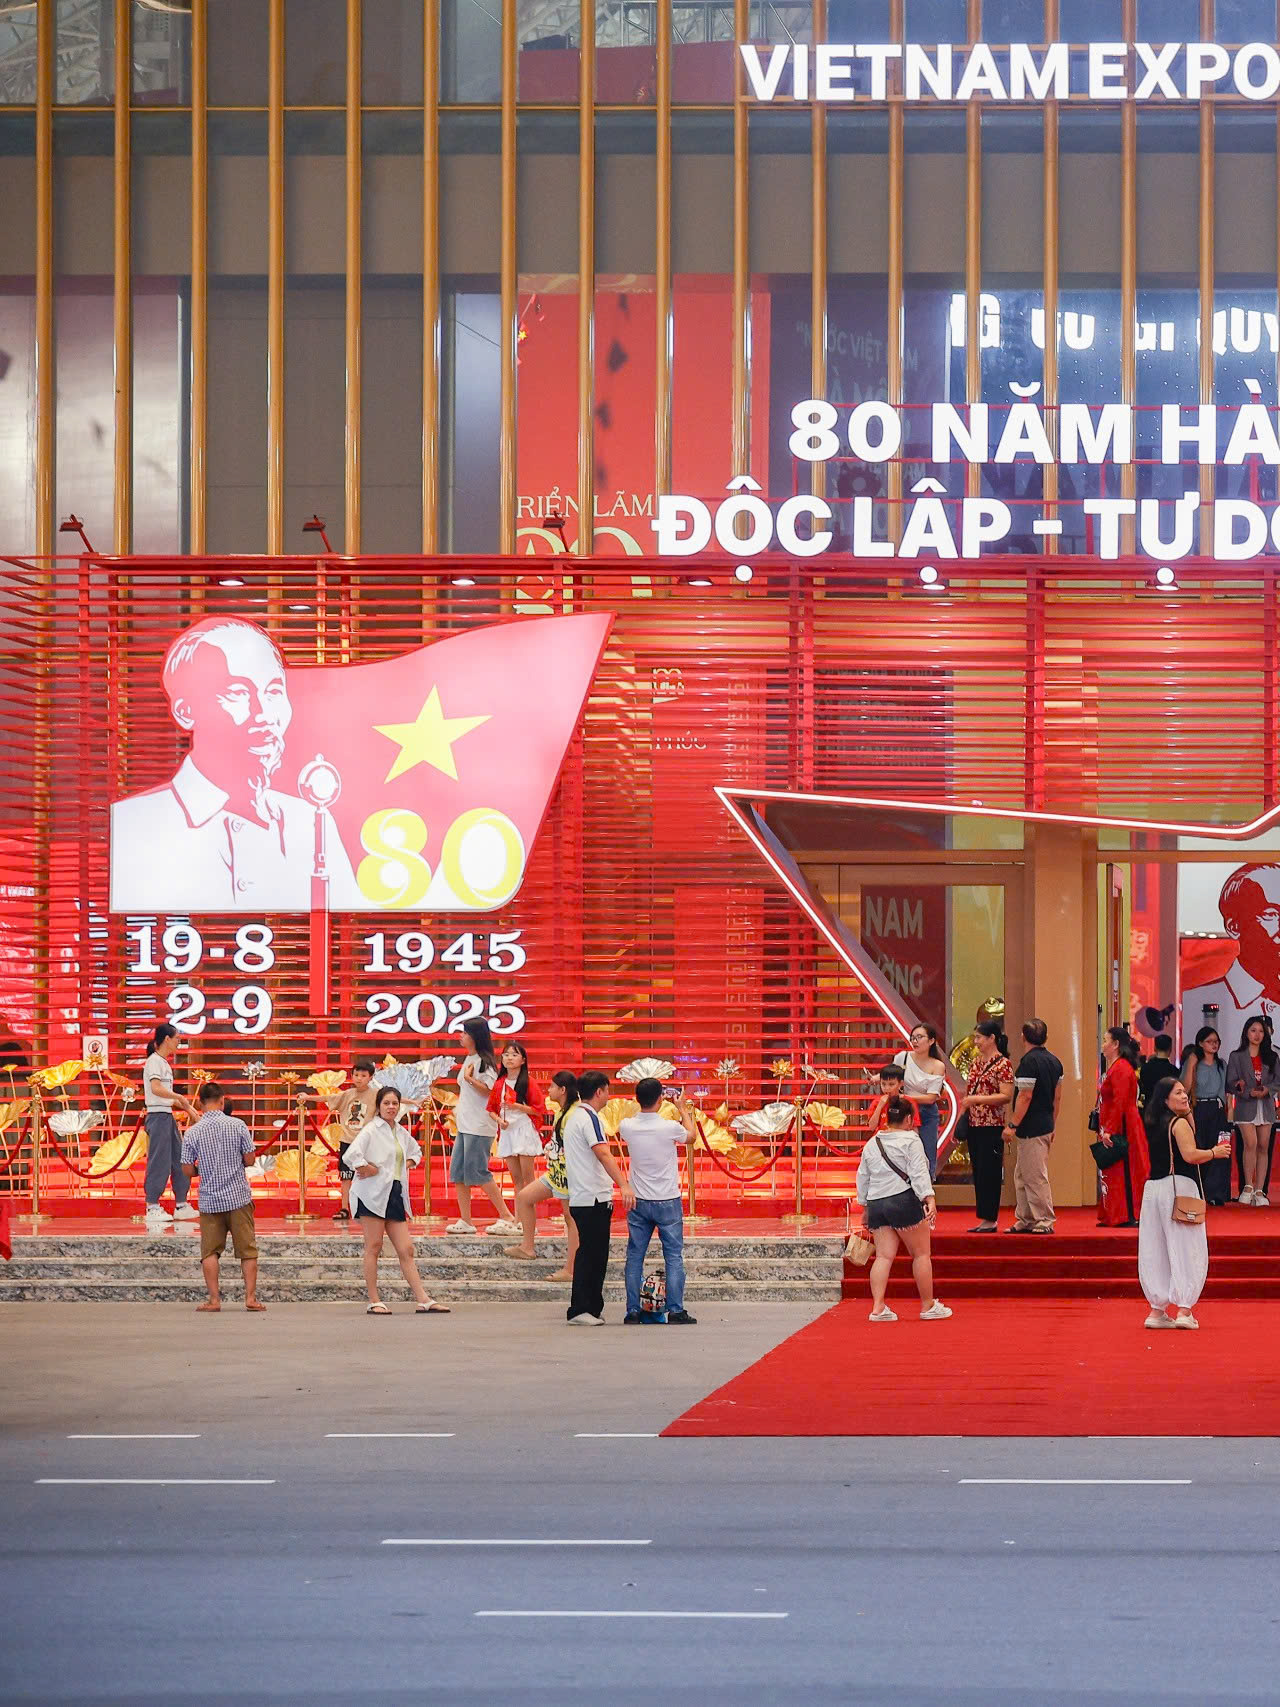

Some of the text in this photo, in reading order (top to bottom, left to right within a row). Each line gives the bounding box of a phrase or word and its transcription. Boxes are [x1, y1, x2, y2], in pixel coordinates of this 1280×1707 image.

[740, 43, 1069, 101] VIETNAM
[788, 399, 902, 463] 80
[932, 381, 1131, 464] NĂM
[517, 485, 655, 519] RIỂN LÃM
[651, 475, 833, 582] ĐỘC
[853, 477, 1012, 583] LẬP
[1033, 519, 1063, 535] -
[1083, 491, 1200, 584] TỰ
[356, 806, 527, 909] 80
[865, 895, 923, 940] NAM
[363, 930, 527, 974] 1945
[365, 992, 527, 1036] 2025
